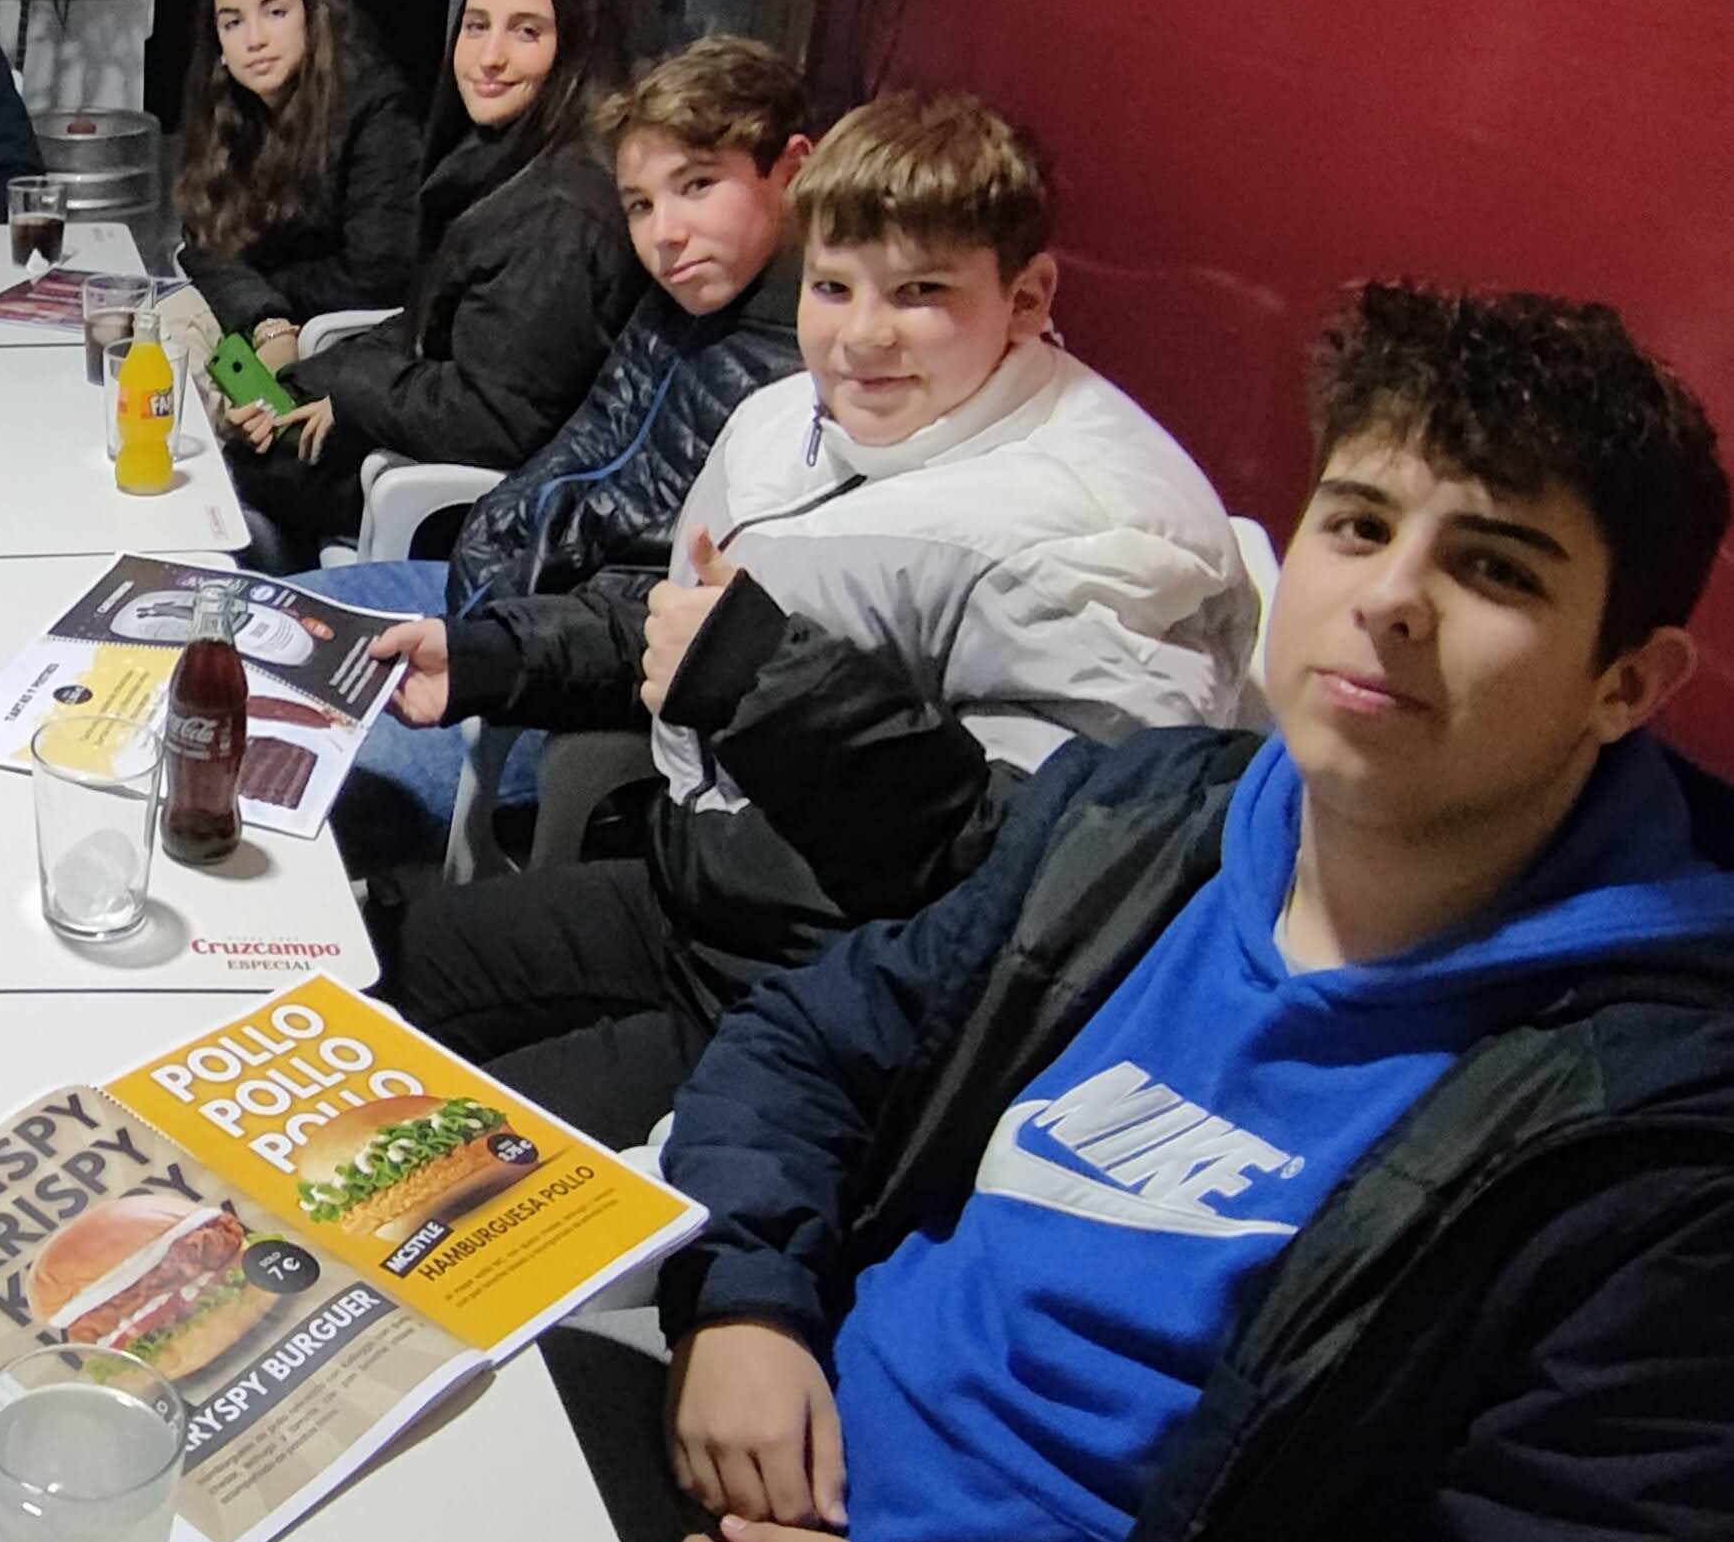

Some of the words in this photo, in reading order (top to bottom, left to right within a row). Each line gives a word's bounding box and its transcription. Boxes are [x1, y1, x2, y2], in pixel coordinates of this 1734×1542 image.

[191, 937, 341, 959] Cruzcampo
[227, 959, 313, 971] ESPECIAL
[151, 1004, 325, 1104] POLLO
[197, 1036, 374, 1138] POLLO
[1031, 1059, 1284, 1221] NIKE
[386, 1221, 445, 1275] MCSTYLE
[417, 1198, 547, 1281] HAMBURGUESA
[540, 1165, 595, 1204] POLLO
[186, 1371, 267, 1453] RYSPY
[261, 1289, 382, 1388] BURGUER
